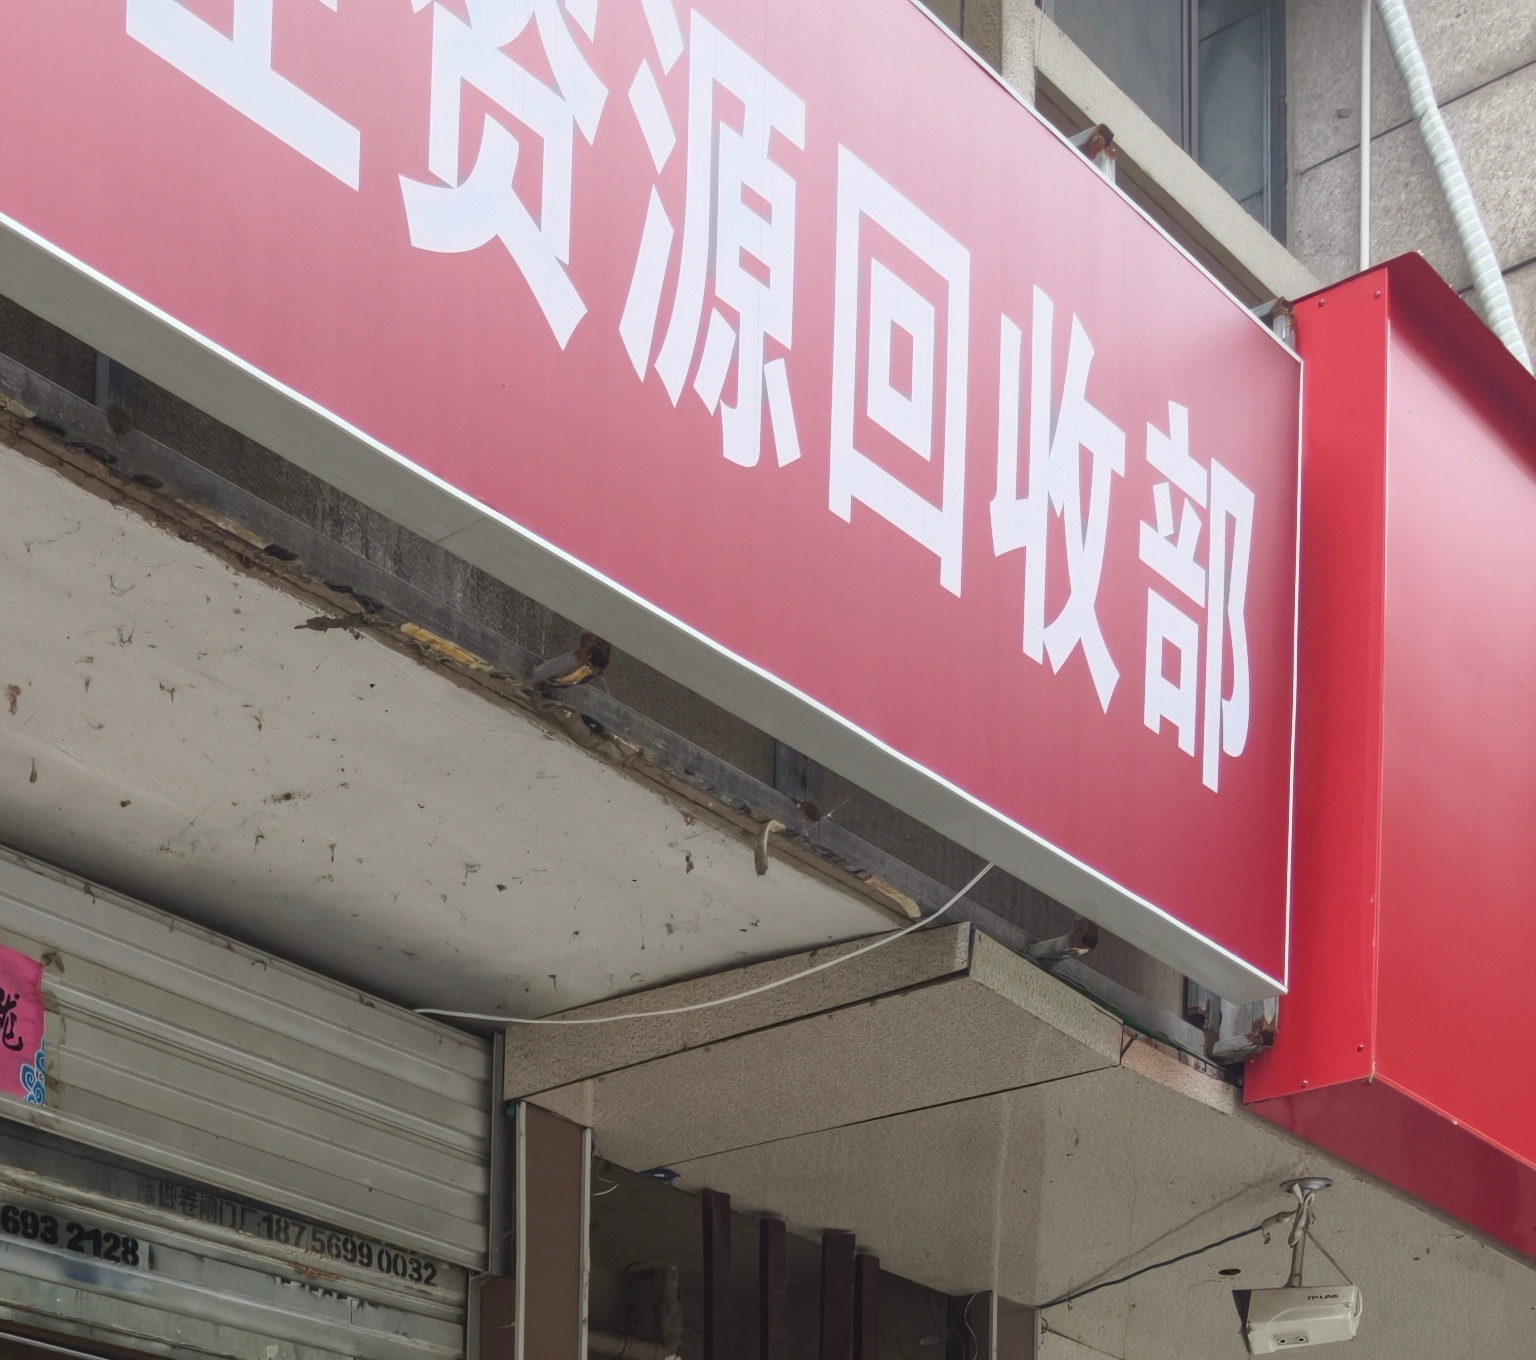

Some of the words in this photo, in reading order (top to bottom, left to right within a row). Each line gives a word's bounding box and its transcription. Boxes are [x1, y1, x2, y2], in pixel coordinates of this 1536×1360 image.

[66, 1222, 140, 1268] 2128
[309, 1231, 374, 1269] 5699
[377, 1250, 439, 1288] 0032
